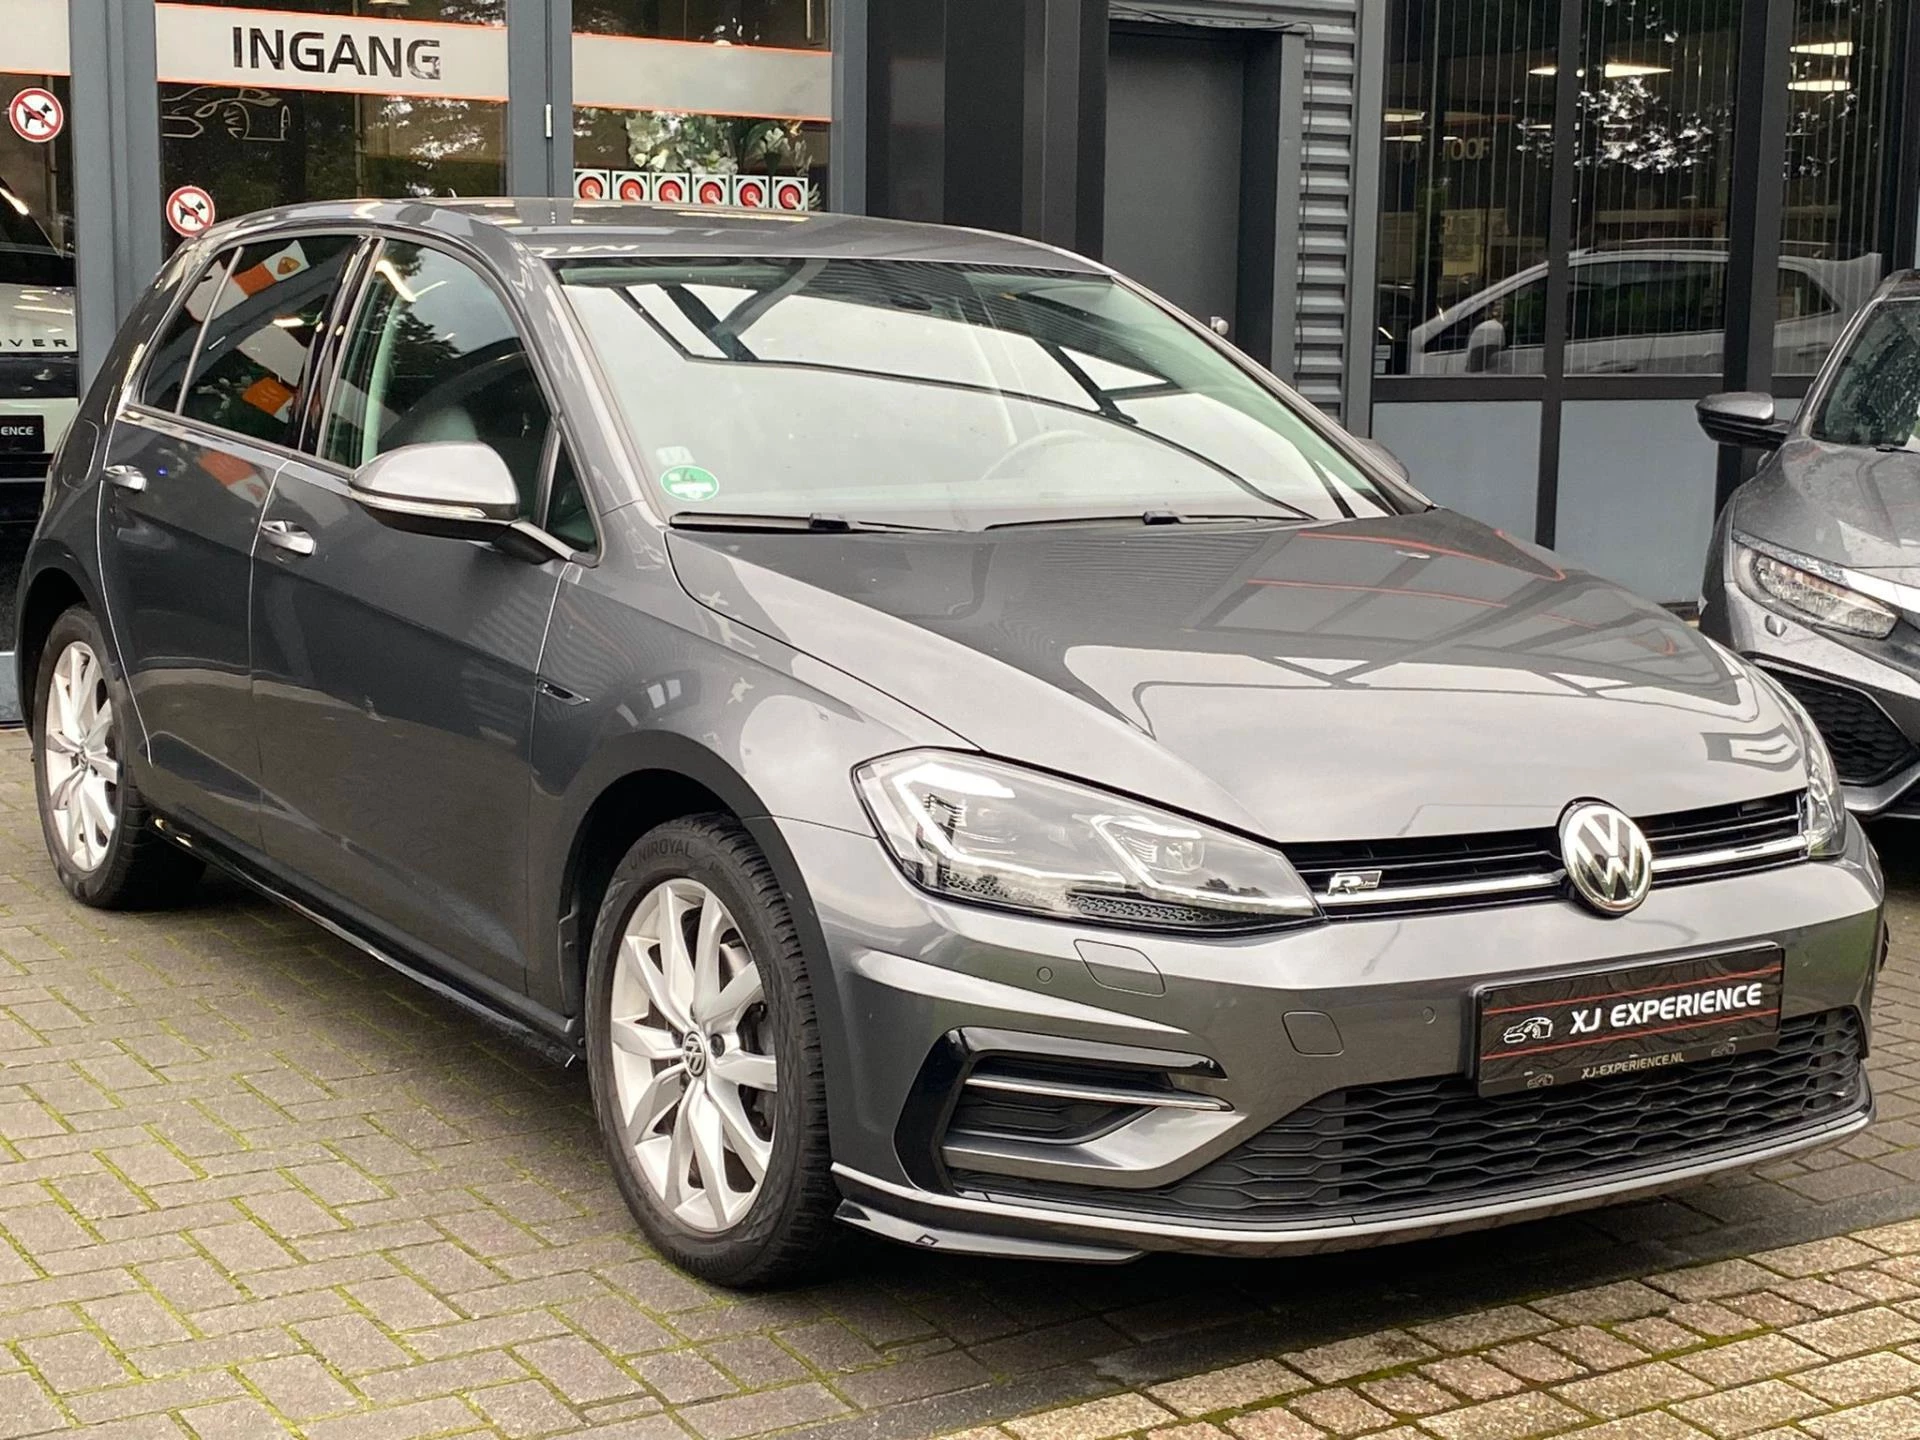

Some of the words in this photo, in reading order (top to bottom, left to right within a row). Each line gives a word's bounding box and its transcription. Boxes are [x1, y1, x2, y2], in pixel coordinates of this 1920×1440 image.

[232, 26, 441, 81] INGANG
[0, 338, 69, 347] VER
[628, 837, 694, 871] UNIROYAL
[1569, 1007, 1602, 1035] XJ
[1610, 982, 1763, 1028] EXPERIENCE
[1580, 1051, 1685, 1080] XJ-EXPERIENCE.NL
